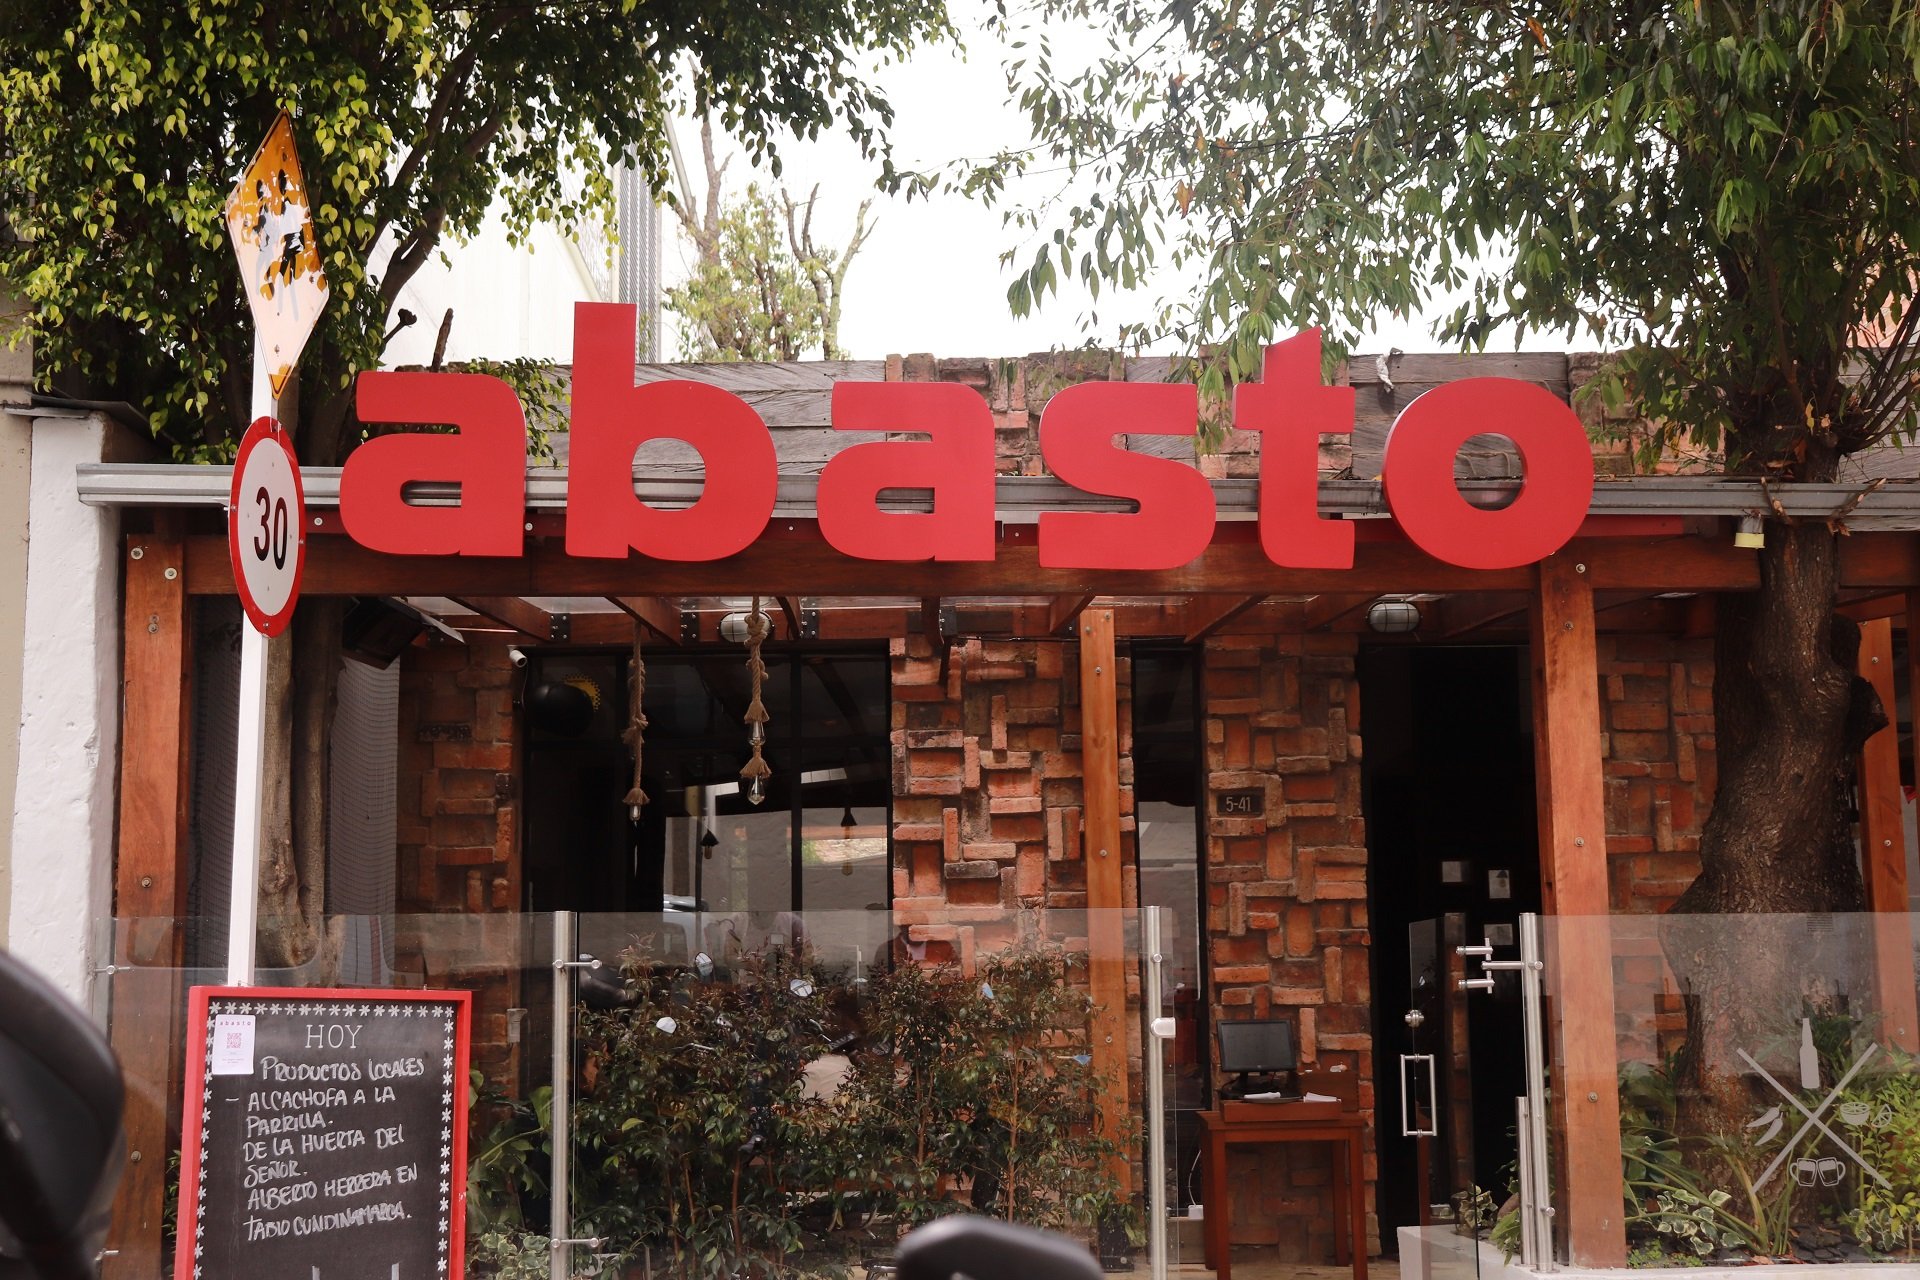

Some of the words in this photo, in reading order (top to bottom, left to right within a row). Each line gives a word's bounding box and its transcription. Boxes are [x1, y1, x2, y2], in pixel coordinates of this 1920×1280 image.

[339, 301, 1594, 570] abasto
[254, 486, 288, 570] 30
[1225, 796, 1252, 812] 5-41
[305, 1023, 364, 1049] HOY
[260, 1055, 362, 1082] PRODUCTOS
[368, 1057, 425, 1081] LOCALES
[247, 1087, 348, 1112] ALCACHOFA
[353, 1089, 366, 1104] A
[374, 1085, 396, 1103] LA
[242, 1141, 268, 1162] DE
[273, 1136, 295, 1156] LA
[301, 1129, 366, 1154] HUERTA
[374, 1123, 405, 1150] DEL
[247, 1180, 318, 1210] ALBERTO
[324, 1169, 392, 1197] HERRERA
[395, 1162, 418, 1184] EN
[242, 1214, 291, 1241] TABIO
